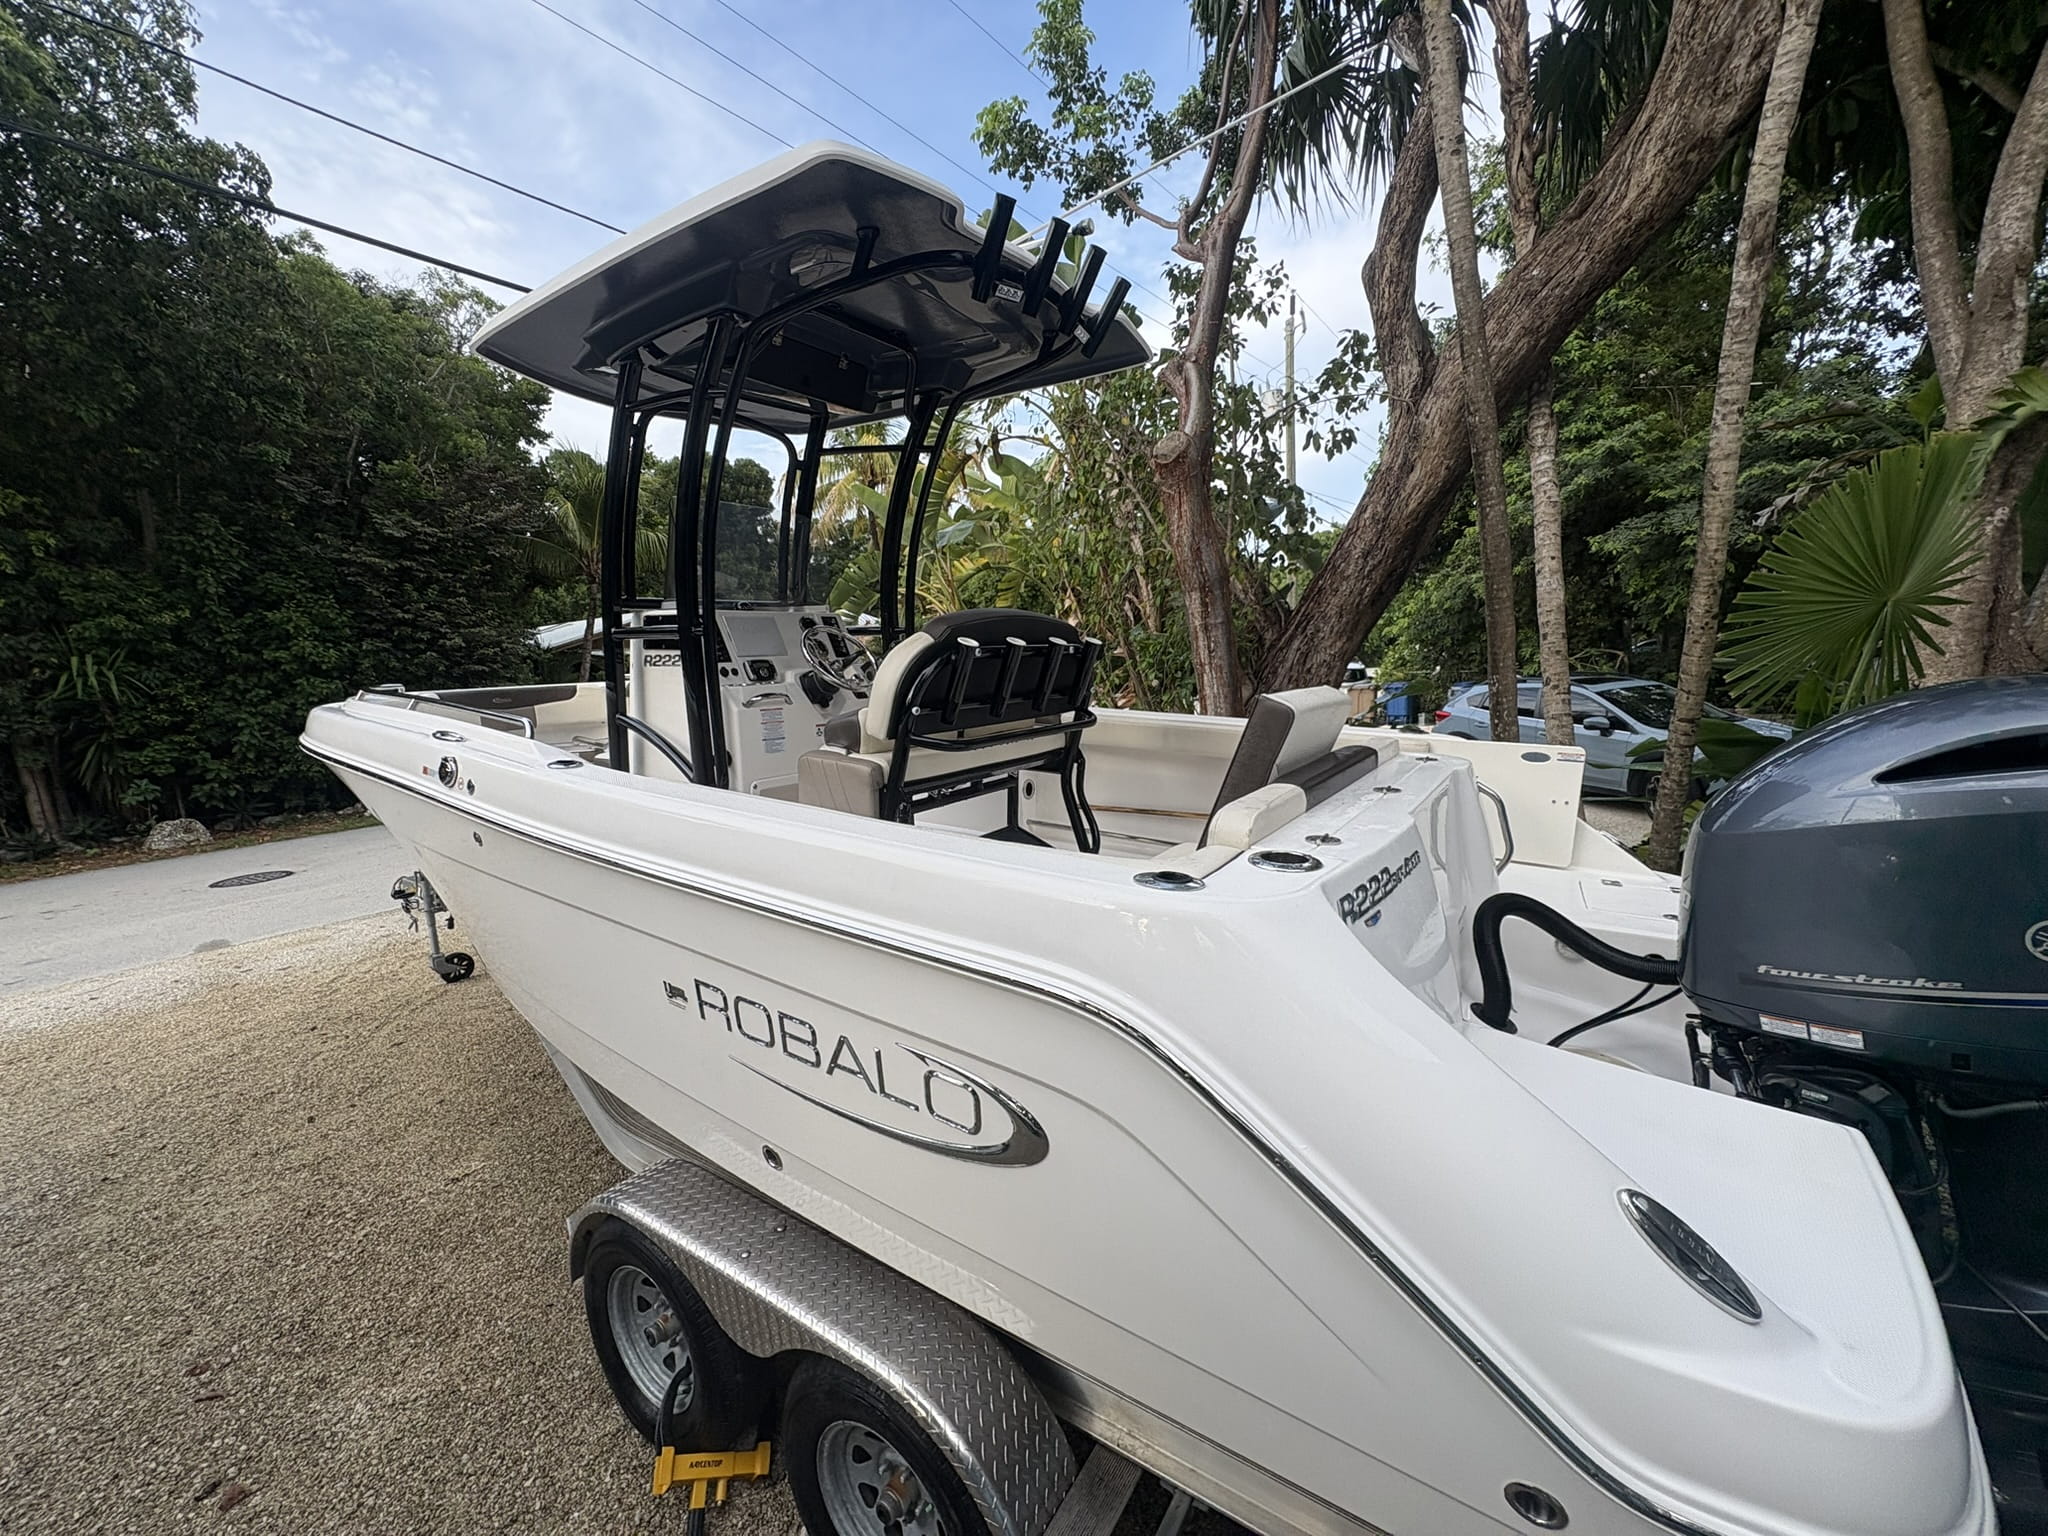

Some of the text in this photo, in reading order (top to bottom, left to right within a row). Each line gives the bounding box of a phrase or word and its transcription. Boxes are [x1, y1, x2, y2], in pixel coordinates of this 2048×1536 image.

[643, 654, 681, 668] R222
[1336, 866, 1396, 925] R222
[1756, 964, 1963, 988] four stroke
[693, 978, 982, 1136] ROBALO
